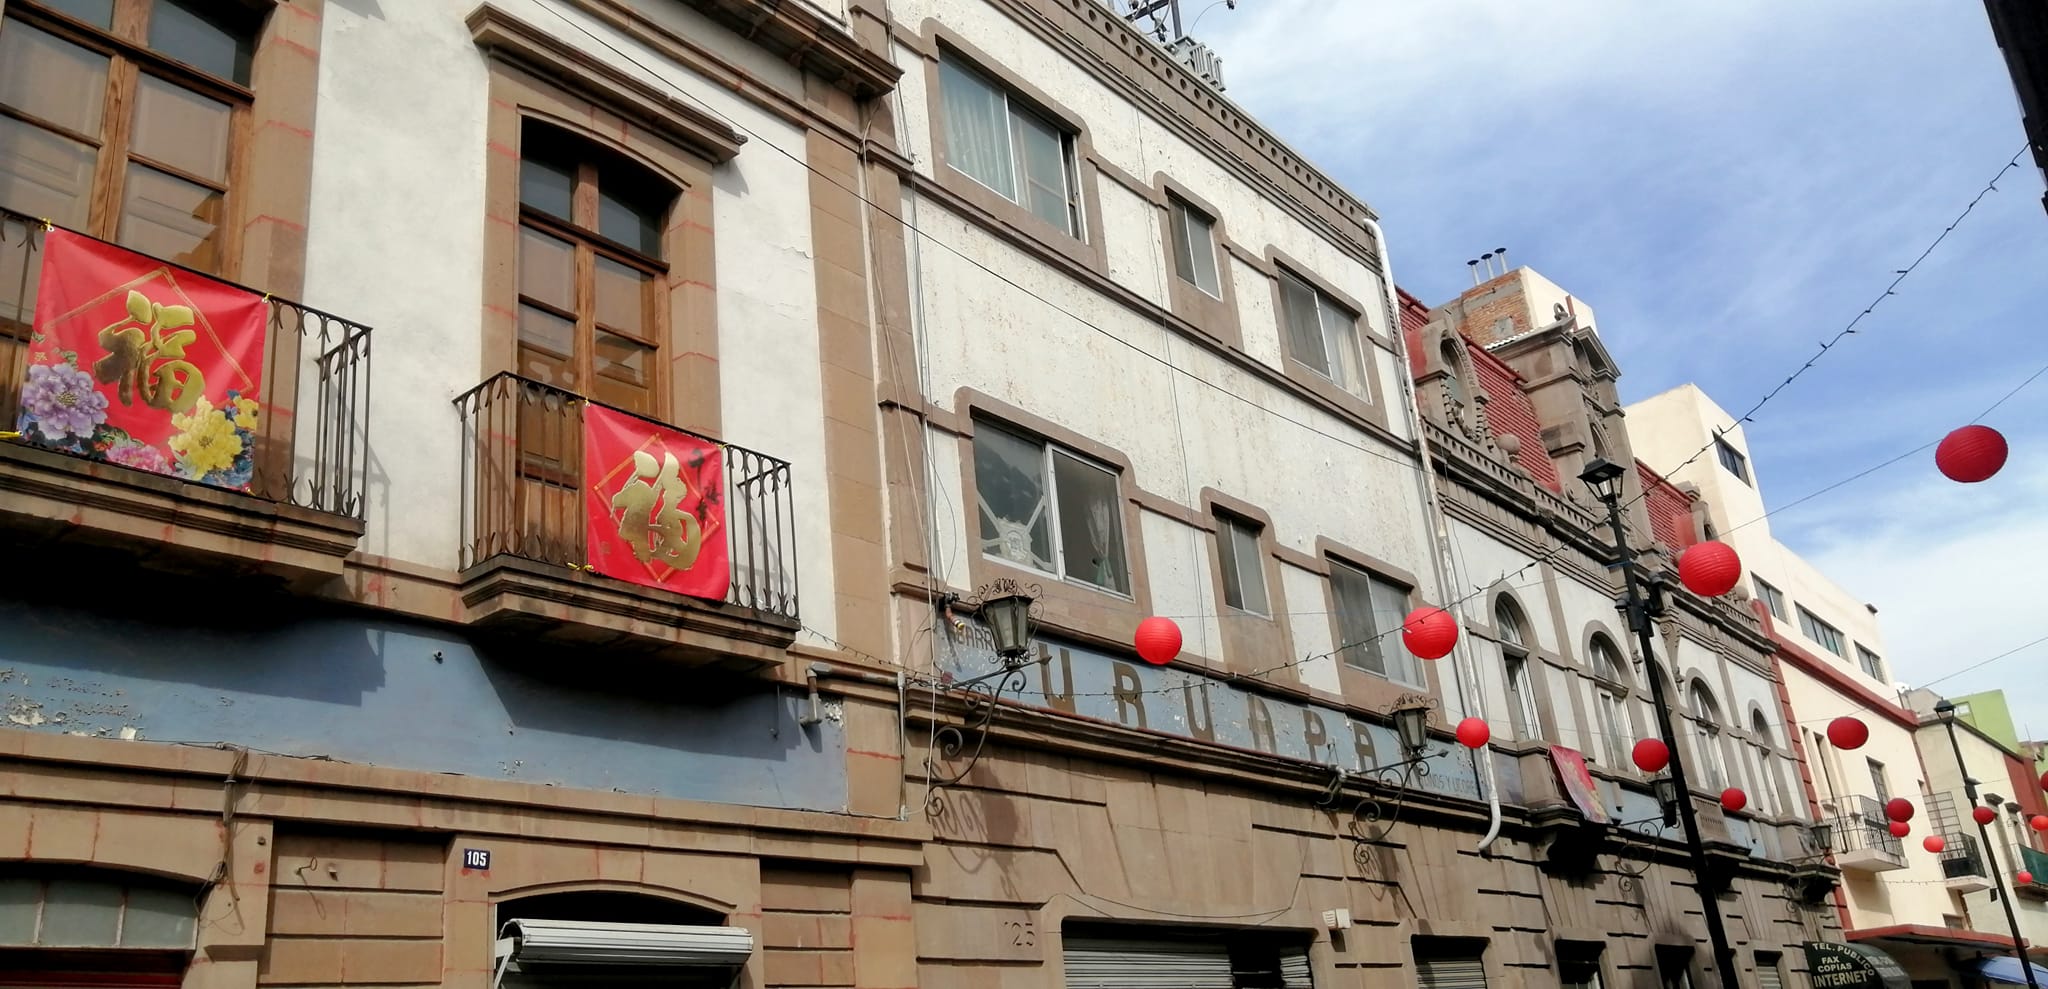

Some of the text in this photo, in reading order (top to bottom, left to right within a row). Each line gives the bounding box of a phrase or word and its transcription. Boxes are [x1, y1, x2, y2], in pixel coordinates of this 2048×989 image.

[93, 290, 205, 414] 福
[611, 450, 702, 571] 福
[467, 850, 487, 867] 105
[1812, 943, 1835, 952] TEL.
[1837, 945, 1875, 976] PUBLICO
[1817, 962, 1852, 973] COPIAS
[1821, 956, 1840, 965] FAX
[1813, 970, 1868, 988] INTERNET
